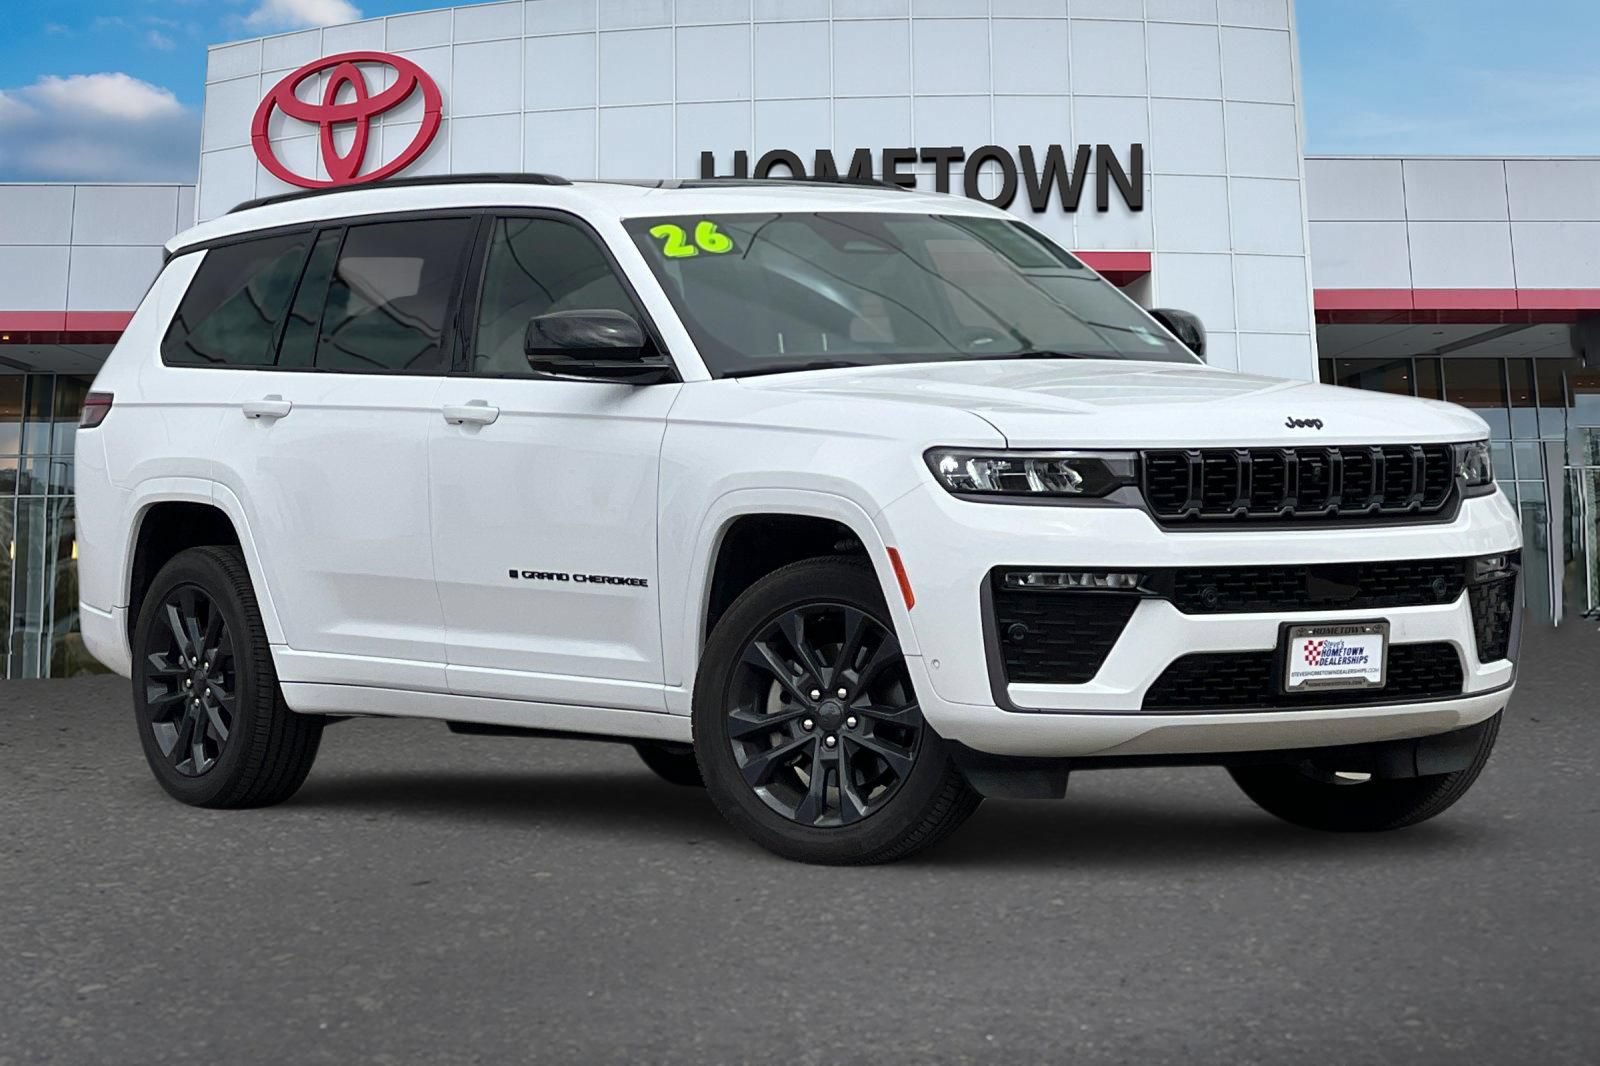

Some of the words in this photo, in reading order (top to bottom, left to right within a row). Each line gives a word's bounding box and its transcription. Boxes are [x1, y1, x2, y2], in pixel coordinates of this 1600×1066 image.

[649, 220, 734, 258] 26
[1285, 416, 1324, 431] Jeep
[521, 570, 569, 581] GRAND
[572, 573, 649, 587] CHEROKEE
[1320, 646, 1365, 658] HOMETOWN
[1319, 655, 1369, 666] DEALERSHIPS
